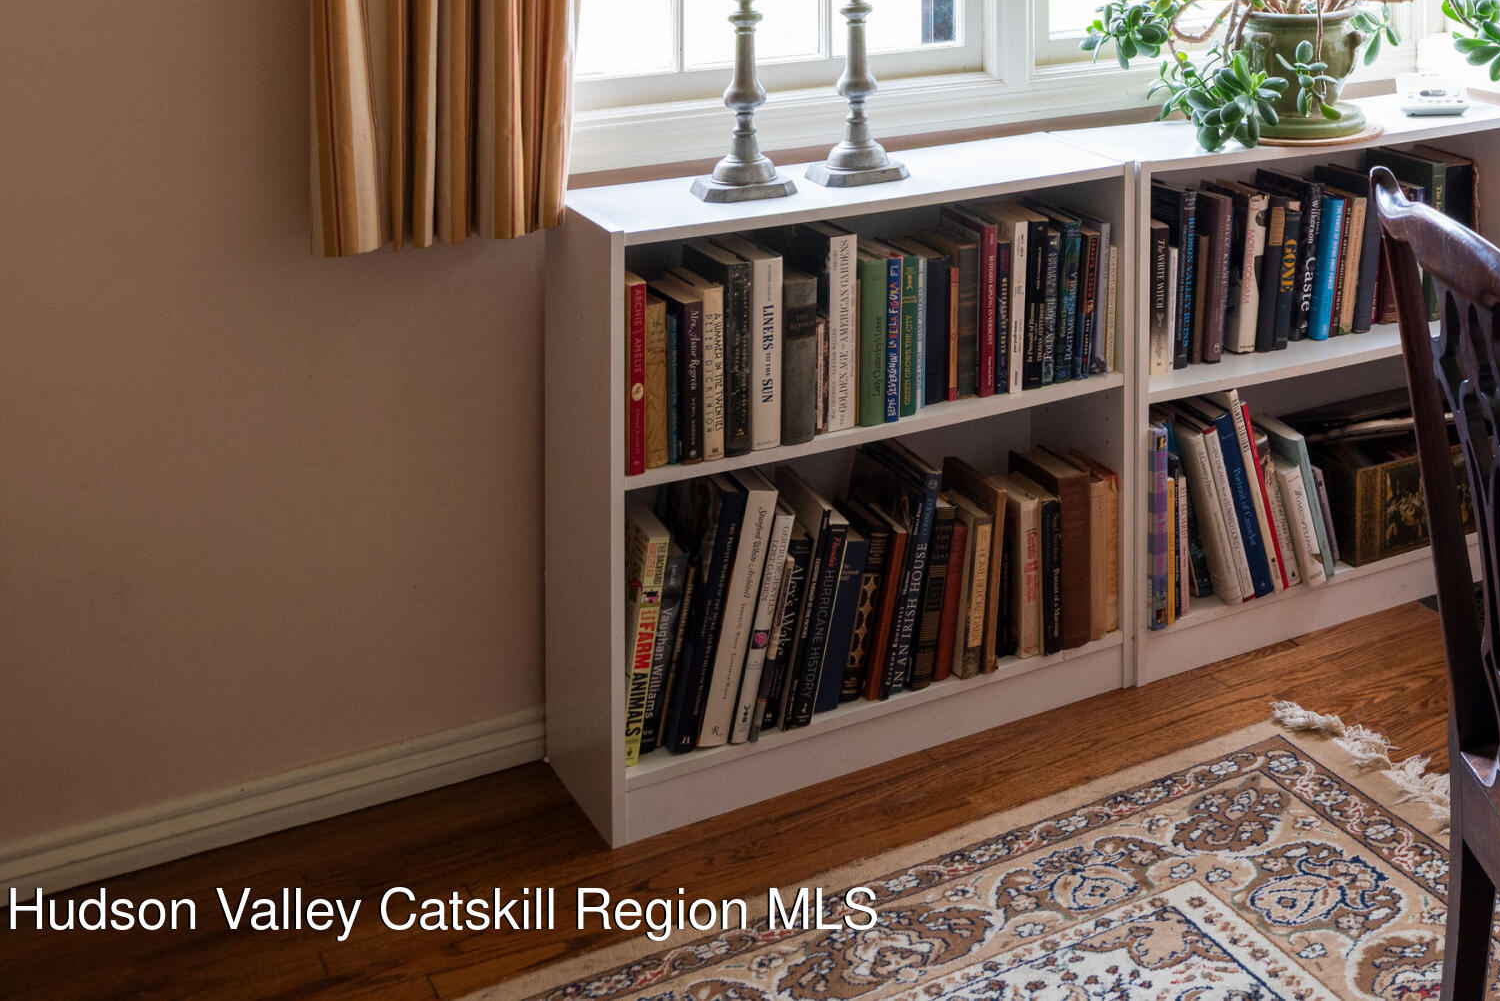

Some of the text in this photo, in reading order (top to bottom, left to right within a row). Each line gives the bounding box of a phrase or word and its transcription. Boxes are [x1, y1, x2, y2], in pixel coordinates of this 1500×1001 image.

[1186, 216, 1195, 262] HUDSON
[1223, 214, 1231, 247] MOLLY
[1307, 200, 1318, 243] Wilkerson
[1245, 228, 1254, 262] MOTHER
[1280, 239, 1296, 291] GONE
[1068, 271, 1077, 300] SIMLA
[1156, 239, 1165, 308] The WHITE WITCH
[1184, 264, 1192, 308] VALLEY
[1300, 256, 1315, 311] Caste
[762, 304, 773, 350] LINERS
[837, 240, 849, 412] GOLDEN AGE AMERICAN GARDENS
[1067, 301, 1075, 314] IN
[634, 289, 642, 373] ARCHIE AMELIE
[687, 310, 700, 390] Mrs. Astor Regrets
[714, 322, 722, 359] SUMMER
[886, 281, 899, 416] BEPPE SEVERGNINI LA BELLA FIGURA
[904, 333, 912, 347] THE
[1063, 317, 1074, 360] RAGTIME
[704, 314, 713, 432] PETER DICKINSON
[765, 352, 770, 361] TO
[714, 373, 722, 388] THE
[761, 378, 772, 402] SUN
[871, 377, 881, 396] Lady
[714, 391, 723, 431] TWENTIES
[1232, 398, 1244, 425] RAILWAY
[1233, 467, 1256, 545] Portrait of Camelot
[653, 541, 666, 584] THE BACKYARD
[743, 506, 767, 598] Stanford White Architect
[760, 539, 779, 601] LOST GARDEN
[775, 525, 789, 572] GERTRUDE
[909, 543, 927, 591] HOUSE
[784, 564, 803, 607] Alex's
[774, 611, 796, 656] Wake
[802, 569, 834, 697] HURRICANE HISTORY
[891, 606, 904, 647] ROOSEVELT
[901, 598, 917, 637] IRISH
[644, 607, 672, 718] Vaughan Williams
[897, 644, 909, 665] AN
[625, 622, 654, 736] FARM ANIMALS
[892, 671, 904, 687] IN
